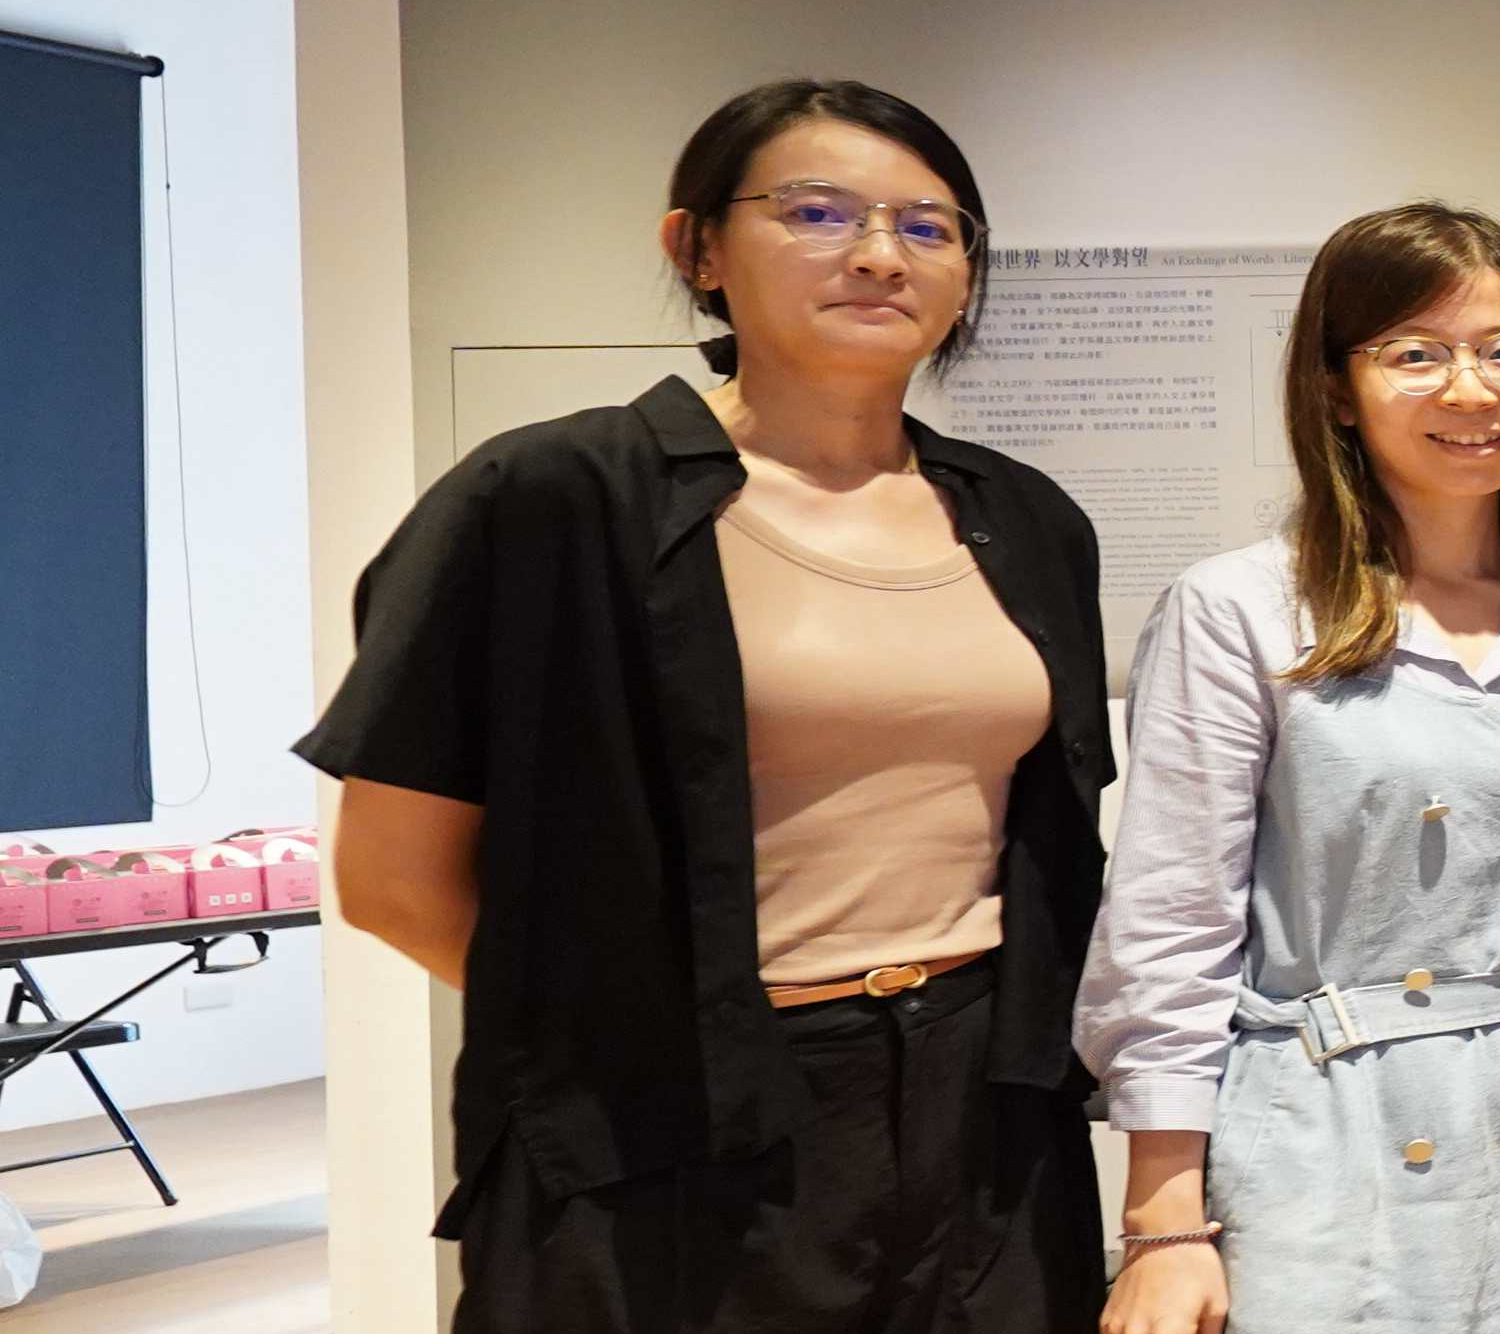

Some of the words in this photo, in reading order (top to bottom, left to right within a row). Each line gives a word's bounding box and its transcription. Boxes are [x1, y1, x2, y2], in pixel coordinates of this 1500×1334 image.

[1054, 247, 1149, 268] 以文學對望
[1178, 255, 1224, 267] Exchange
[1228, 254, 1239, 264] of
[1238, 254, 1275, 264] Words
